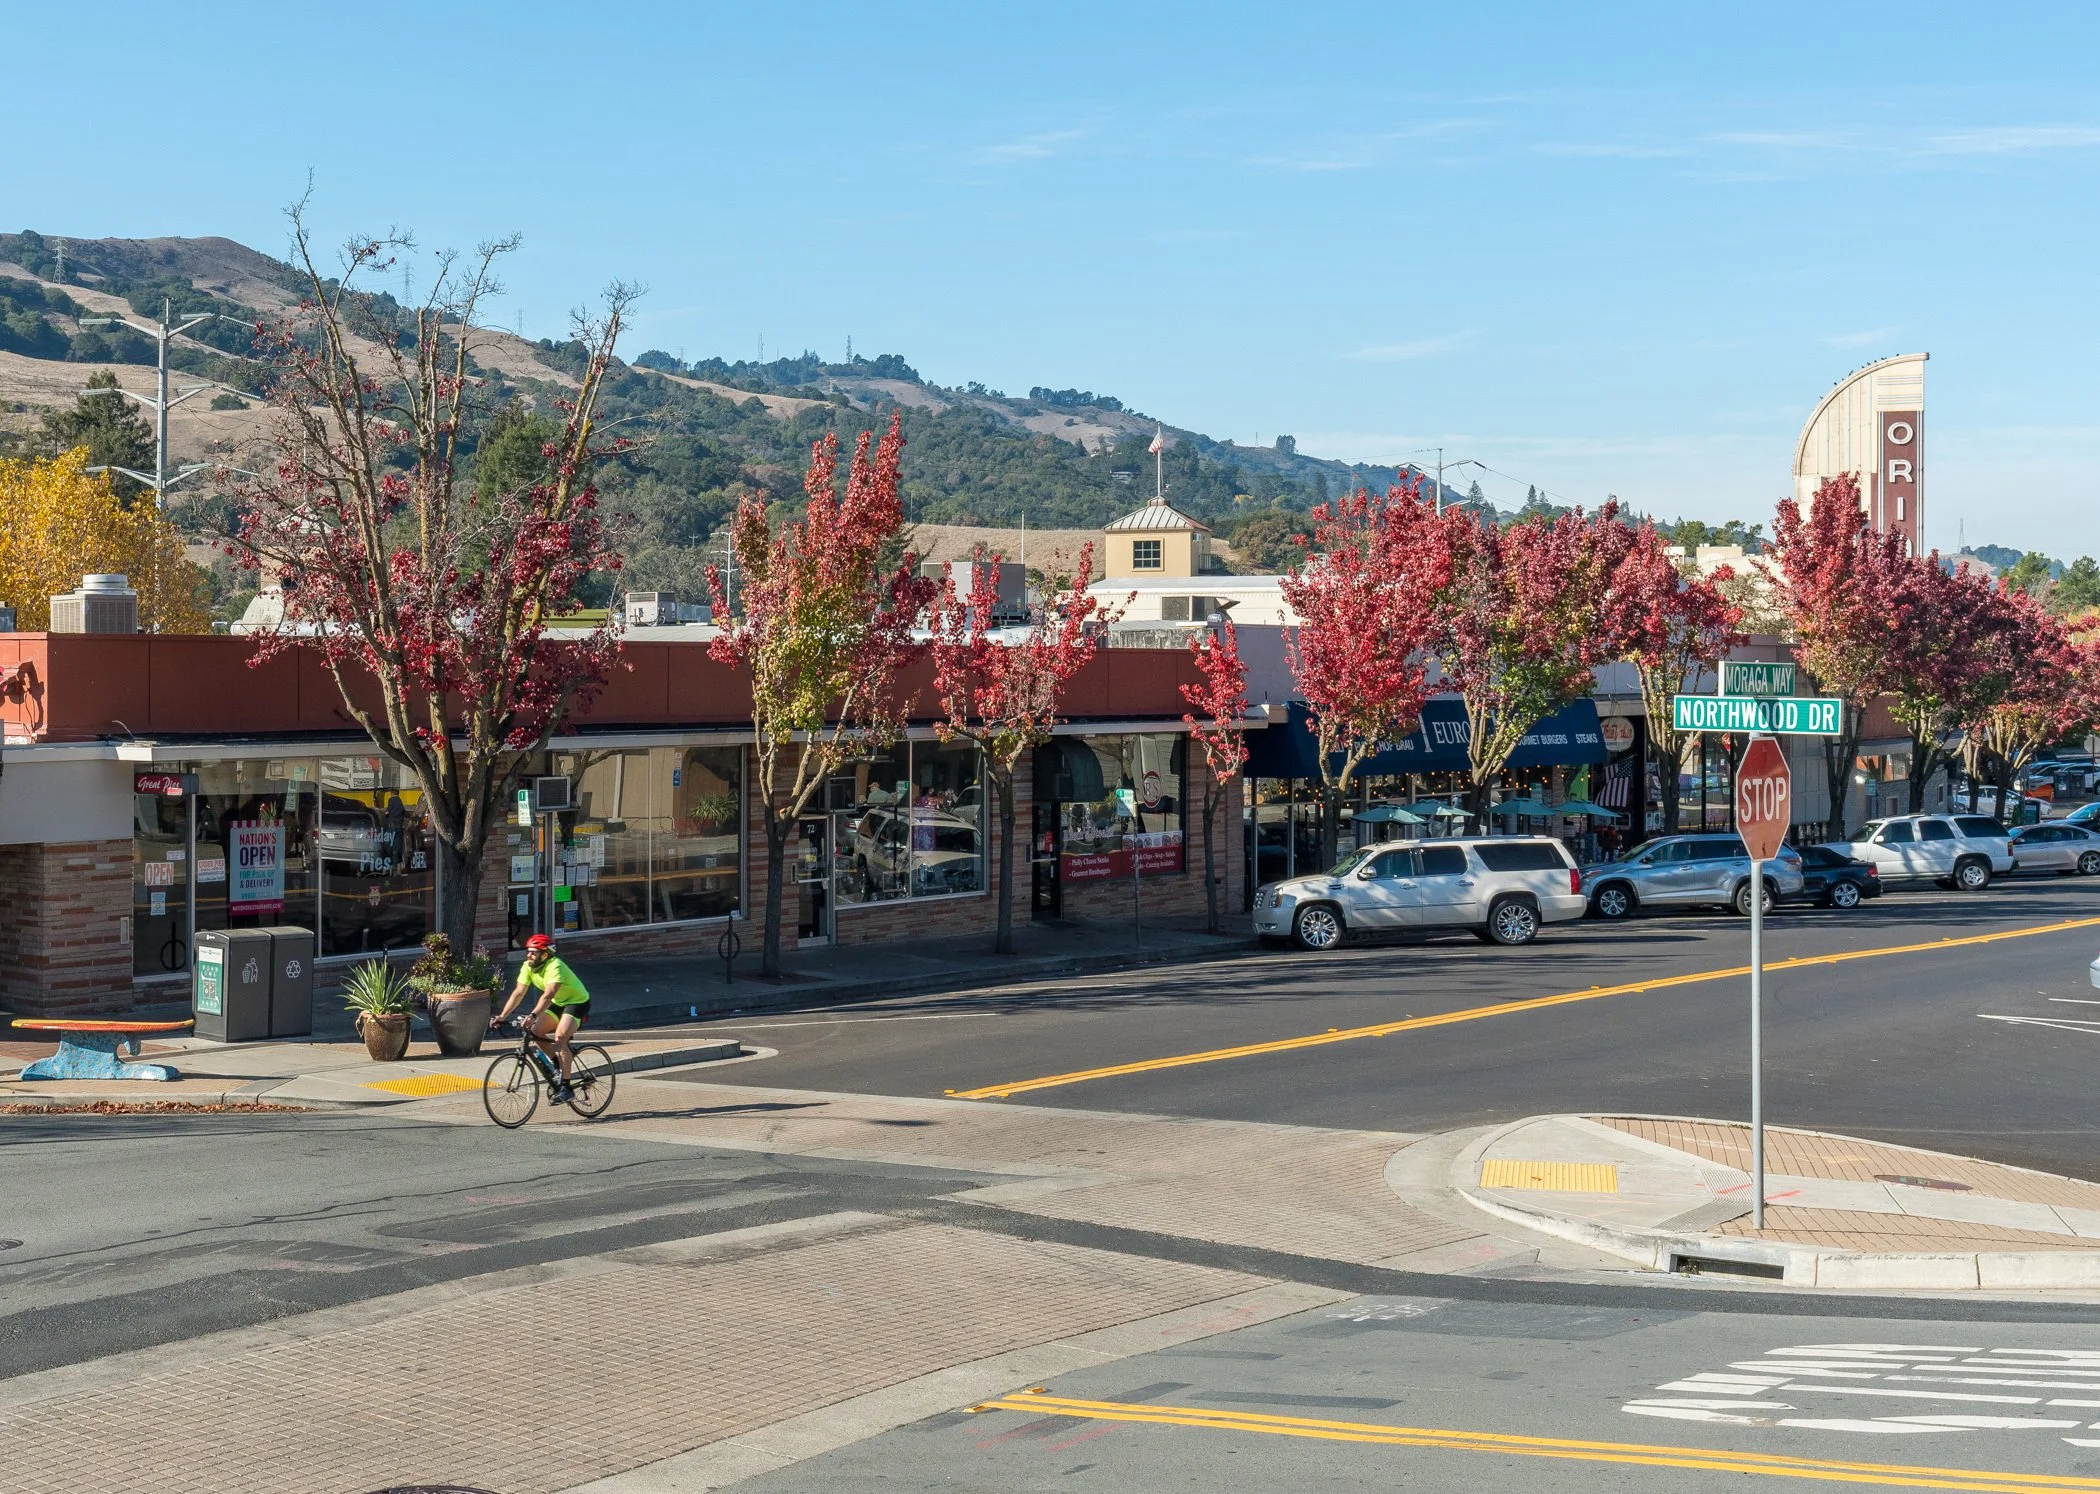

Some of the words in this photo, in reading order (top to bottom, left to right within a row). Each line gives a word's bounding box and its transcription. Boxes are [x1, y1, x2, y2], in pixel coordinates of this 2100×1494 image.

[1725, 665, 1769, 694] MORAGA
[1772, 667, 1793, 694] WAY
[1679, 699, 1798, 730] NORTHWOOD
[1808, 703, 1835, 732] DR
[1541, 734, 1568, 745] BURGERS
[1575, 733, 1598, 744] STEAKS
[137, 776, 161, 791] Great
[162, 776, 180, 792] Pies
[1740, 776, 1787, 823] STOP
[239, 832, 277, 845] NATION'S
[806, 824, 816, 834] 72
[239, 846, 276, 867] OPEN
[360, 851, 392, 872] Pies
[145, 863, 173, 885] OPEN
[245, 879, 274, 888] DELIVERY
